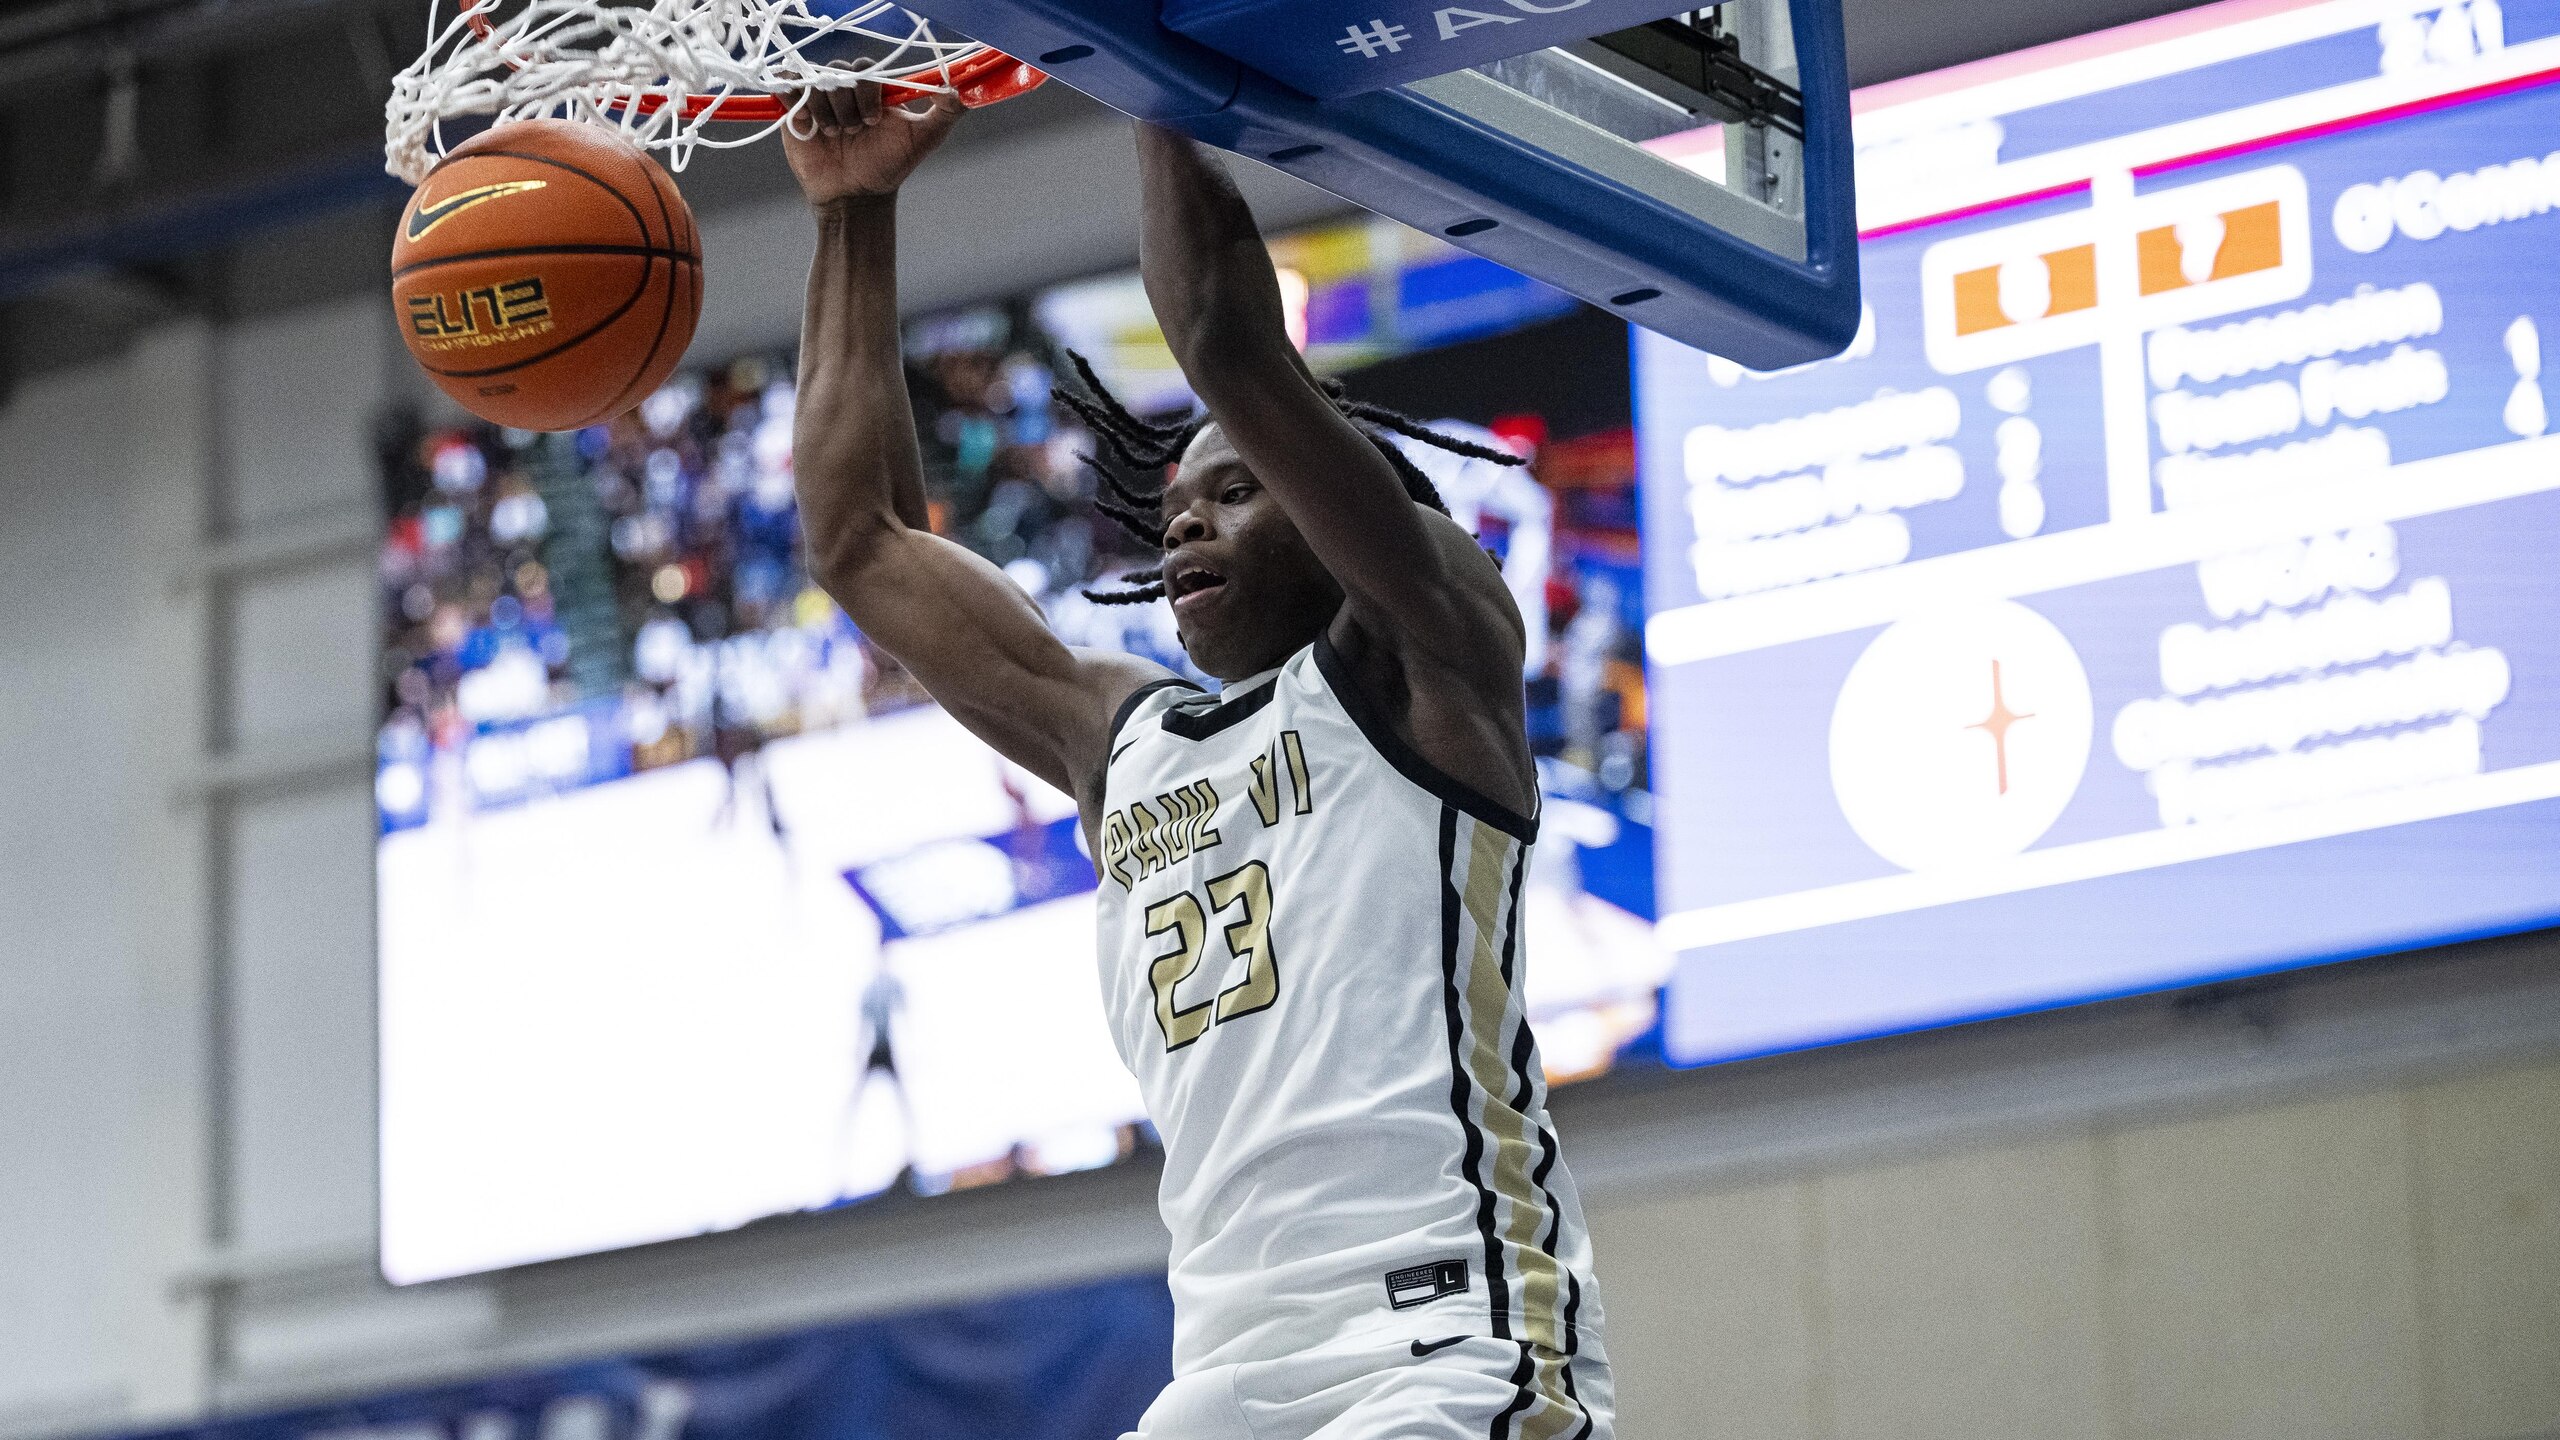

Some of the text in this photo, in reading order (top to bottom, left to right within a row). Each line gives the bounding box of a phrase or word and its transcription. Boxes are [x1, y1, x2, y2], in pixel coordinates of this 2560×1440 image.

[1335, 0, 1593, 59] #A
[407, 276, 552, 337] ELITE
[1105, 730, 1313, 894] PAUL VI
[1145, 859, 1281, 1055] 23
[1390, 1268, 1433, 1281] ENGINEERED
[1444, 1270, 1456, 1284] L
